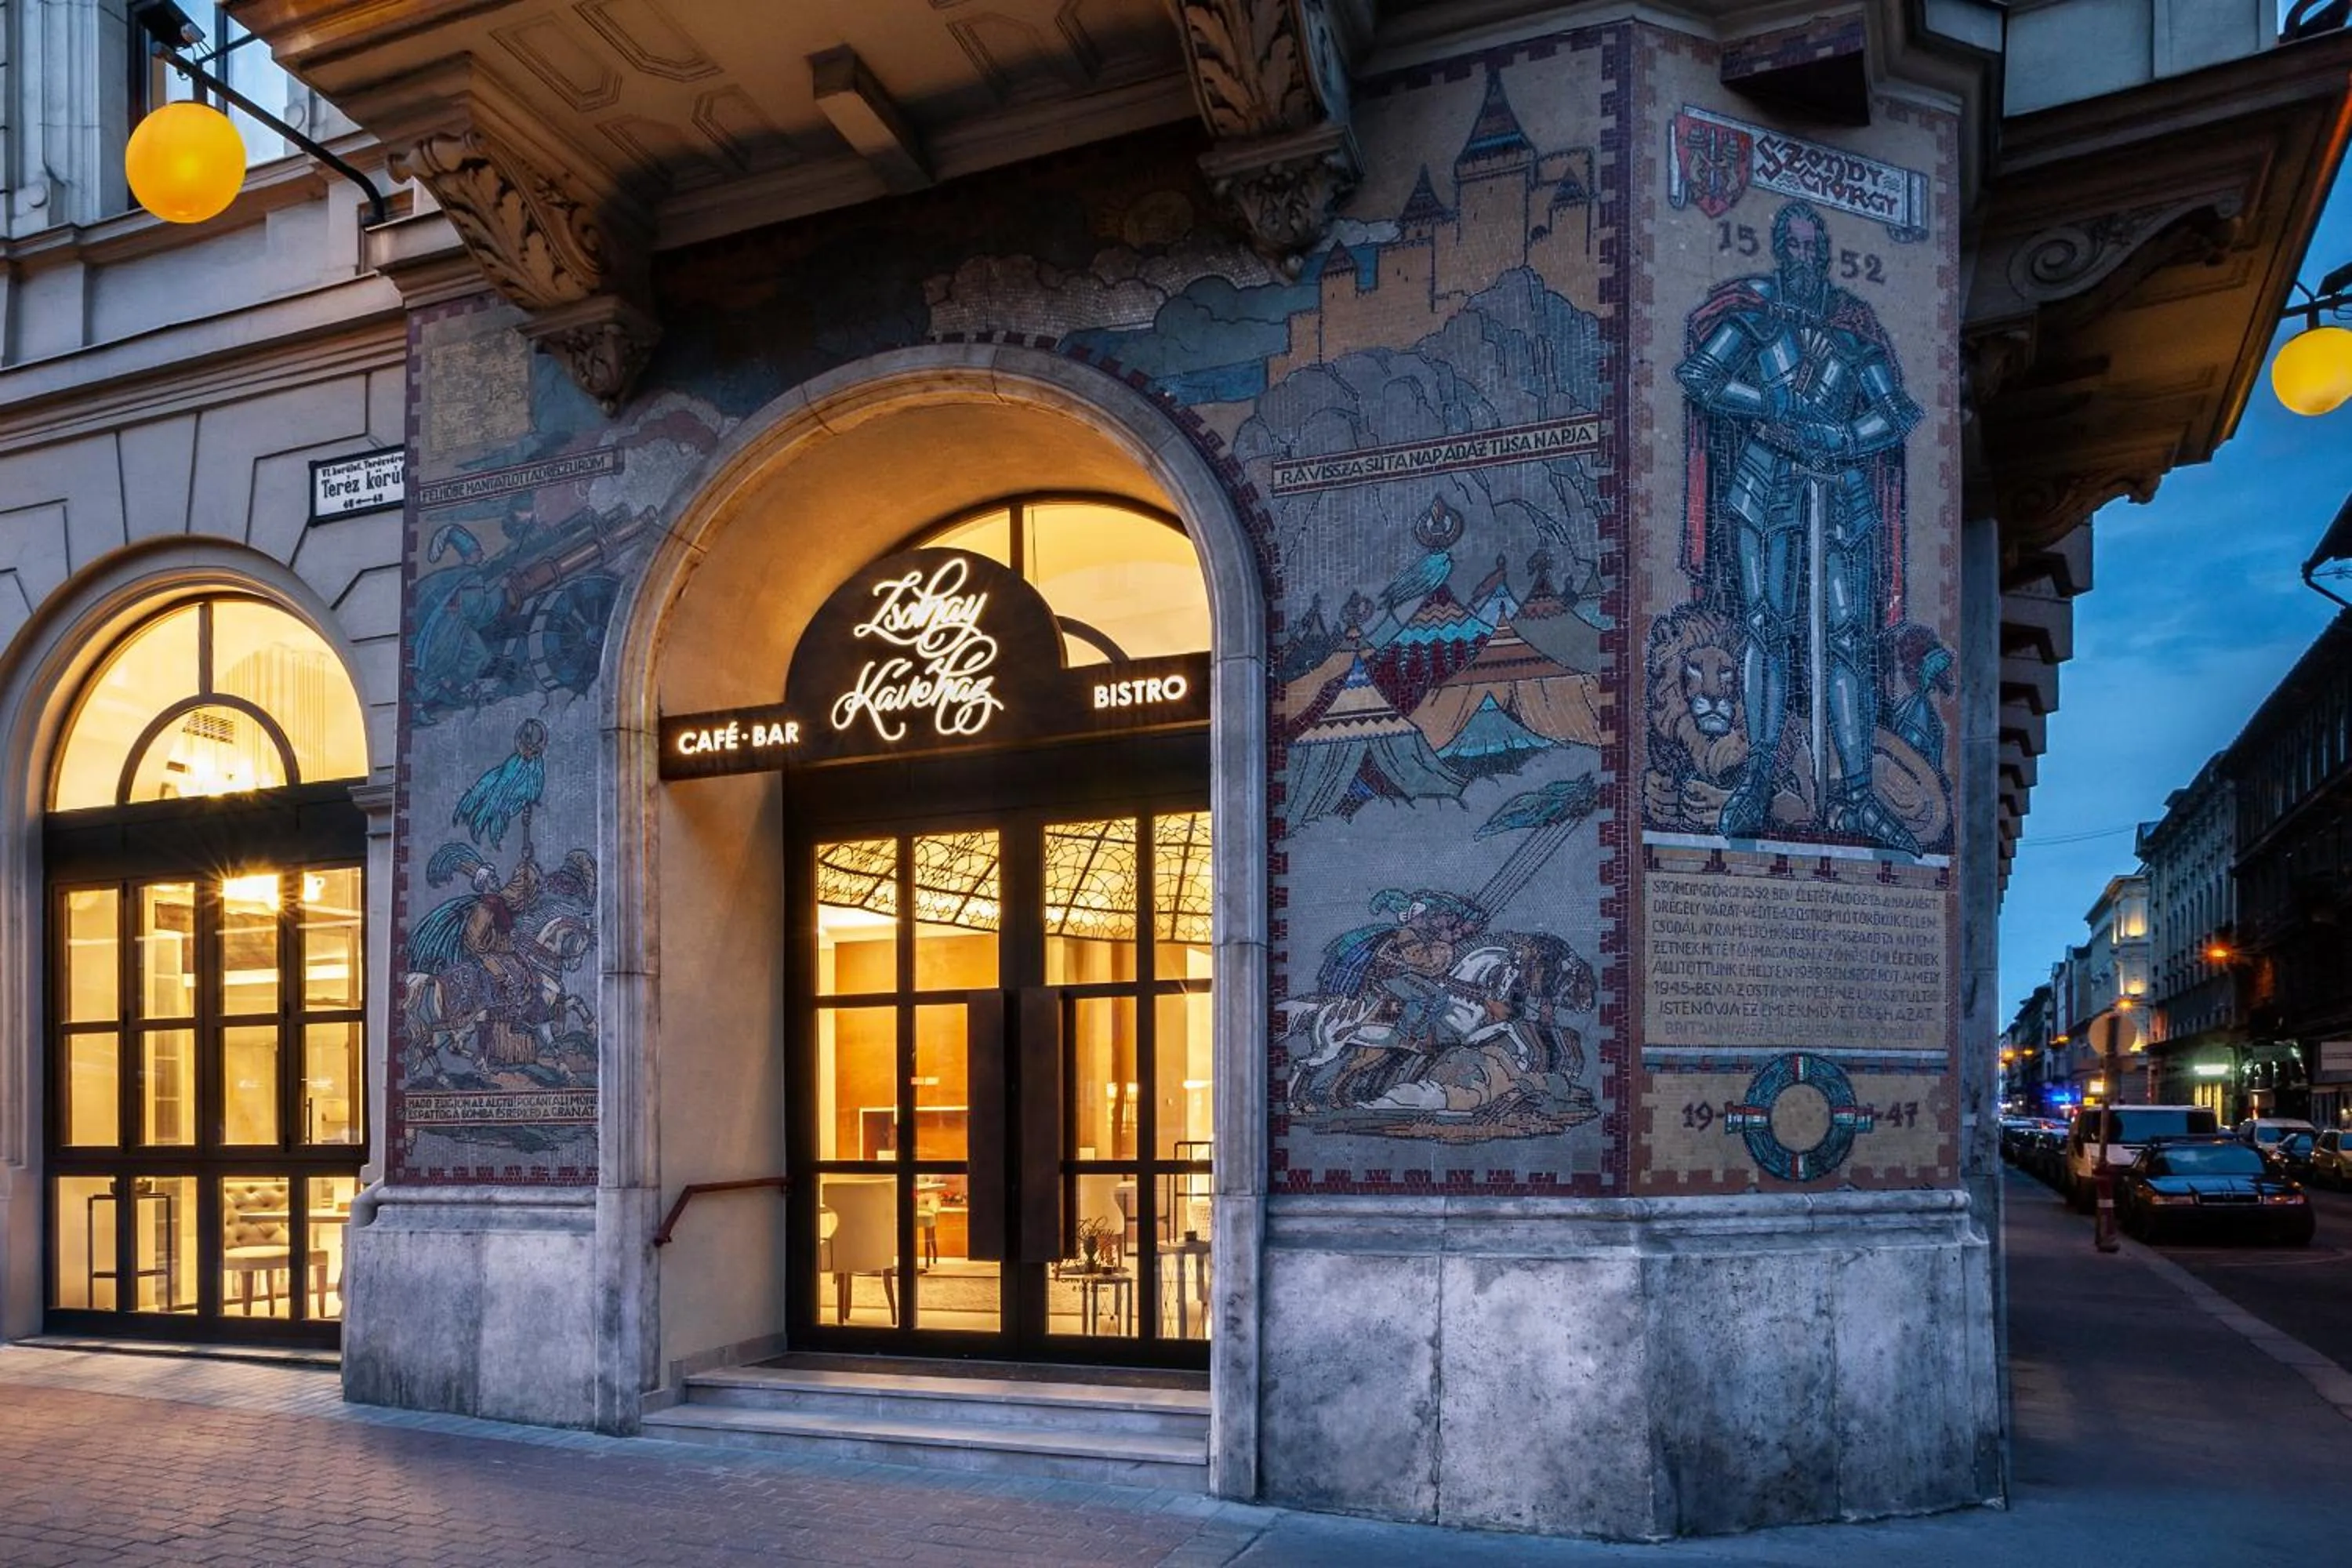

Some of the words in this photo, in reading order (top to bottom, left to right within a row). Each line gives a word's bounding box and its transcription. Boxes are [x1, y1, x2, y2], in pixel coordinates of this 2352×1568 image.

[1717, 218, 1760, 256] 15
[1841, 248, 1886, 285] 52
[364, 455, 405, 469] Terézváro
[321, 474, 360, 498] Teréz
[854, 558, 988, 659] Zsolnay
[1094, 675, 1187, 709] BISTRO
[678, 721, 739, 755] CAFÉ
[752, 721, 799, 747] BAR
